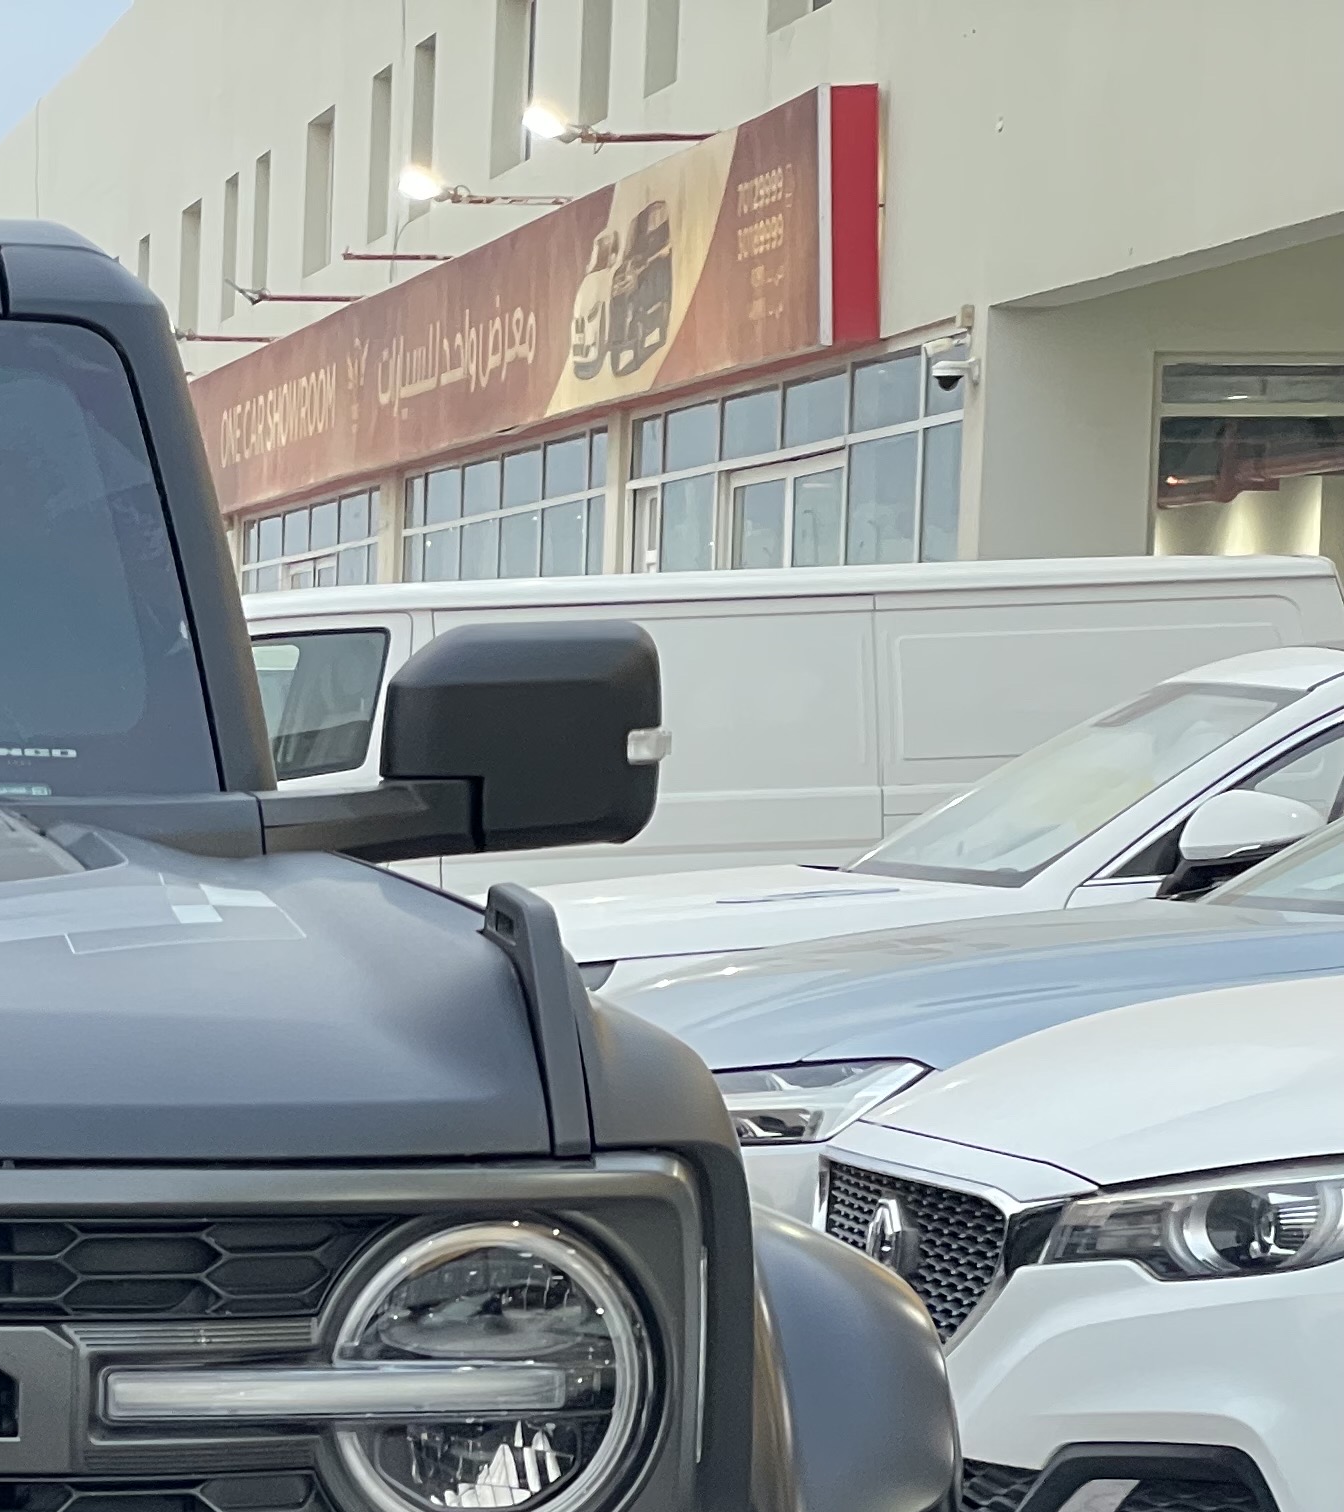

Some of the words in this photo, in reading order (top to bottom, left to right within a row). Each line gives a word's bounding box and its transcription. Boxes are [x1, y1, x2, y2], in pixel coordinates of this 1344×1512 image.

[377, 319, 442, 421] للسيارات
[440, 308, 478, 393] واحد
[478, 294, 537, 388] معرض
[220, 404, 242, 468] ONE
[243, 394, 264, 459] CAR
[266, 362, 337, 451] SHOWROOM
